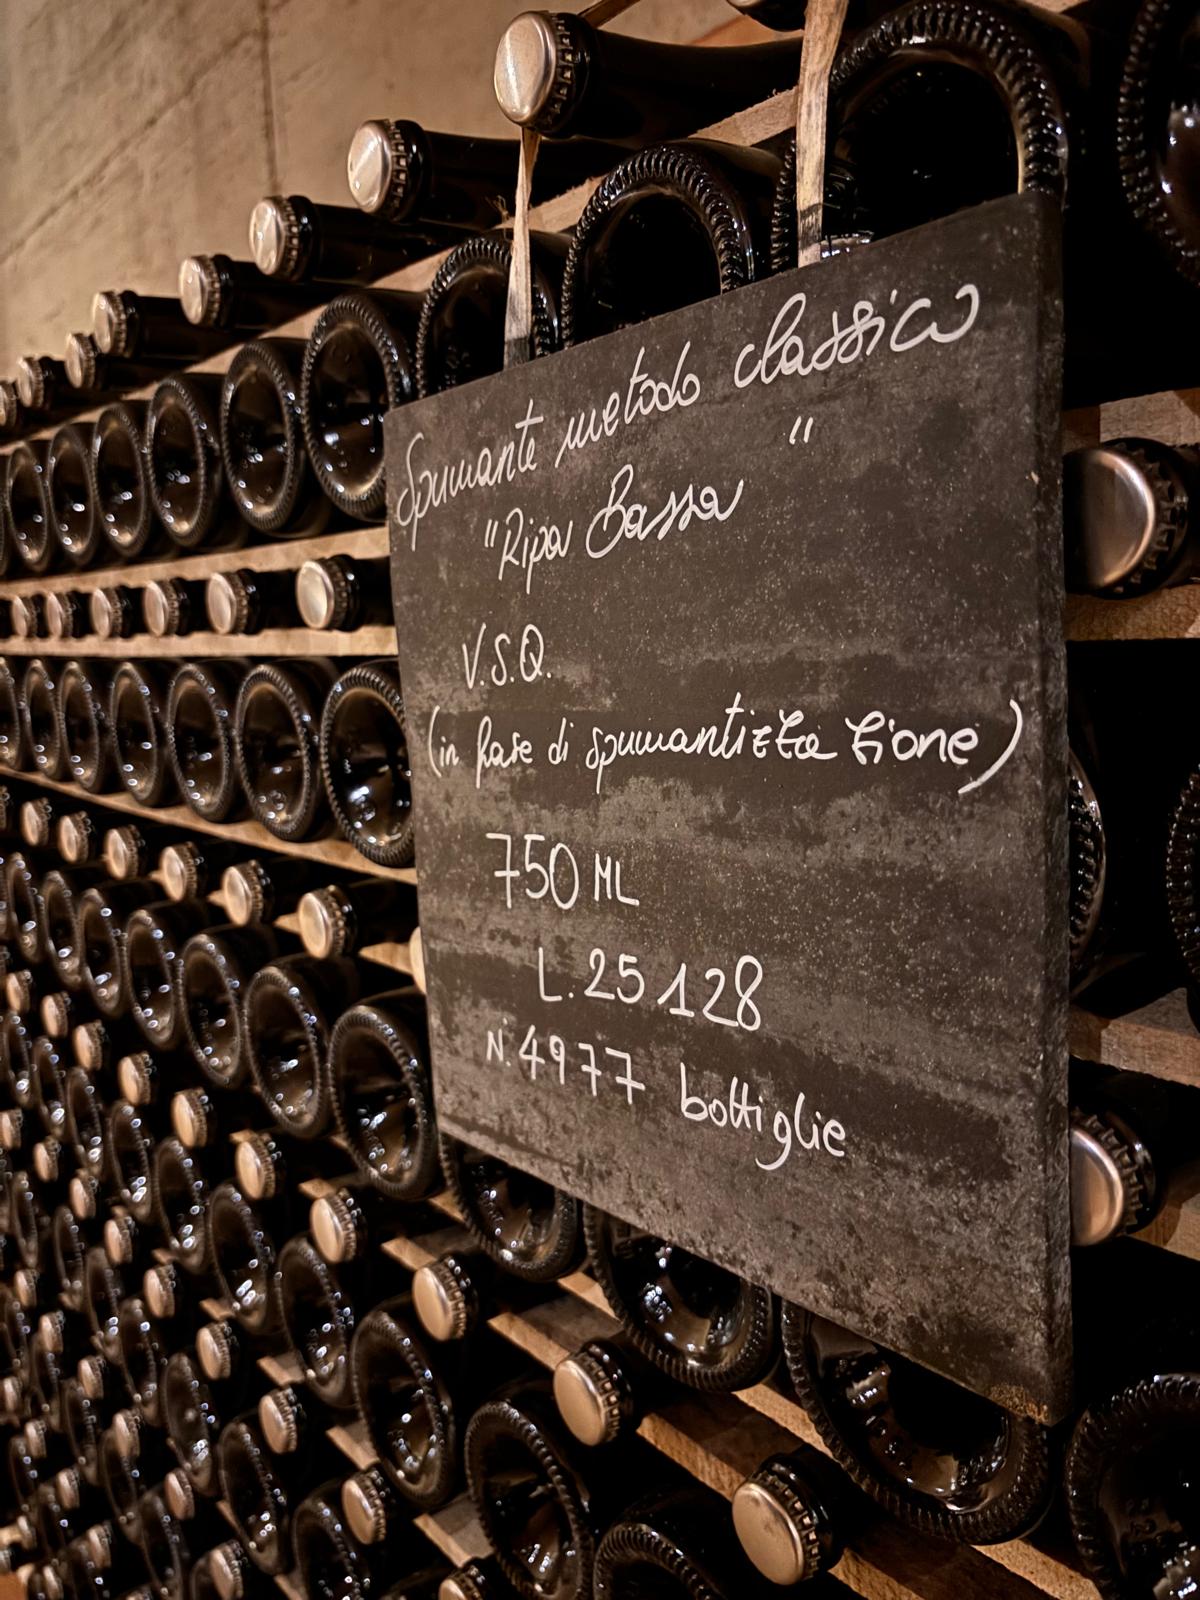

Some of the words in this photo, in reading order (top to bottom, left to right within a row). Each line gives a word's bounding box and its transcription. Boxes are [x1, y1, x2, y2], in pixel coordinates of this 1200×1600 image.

[396, 398, 544, 551] Spumante
[554, 341, 702, 466] metodo
[547, 717, 571, 763] di
[486, 832, 580, 911] 750
[593, 852, 640, 907] ML
[678, 1062, 847, 1171] bottiglie
